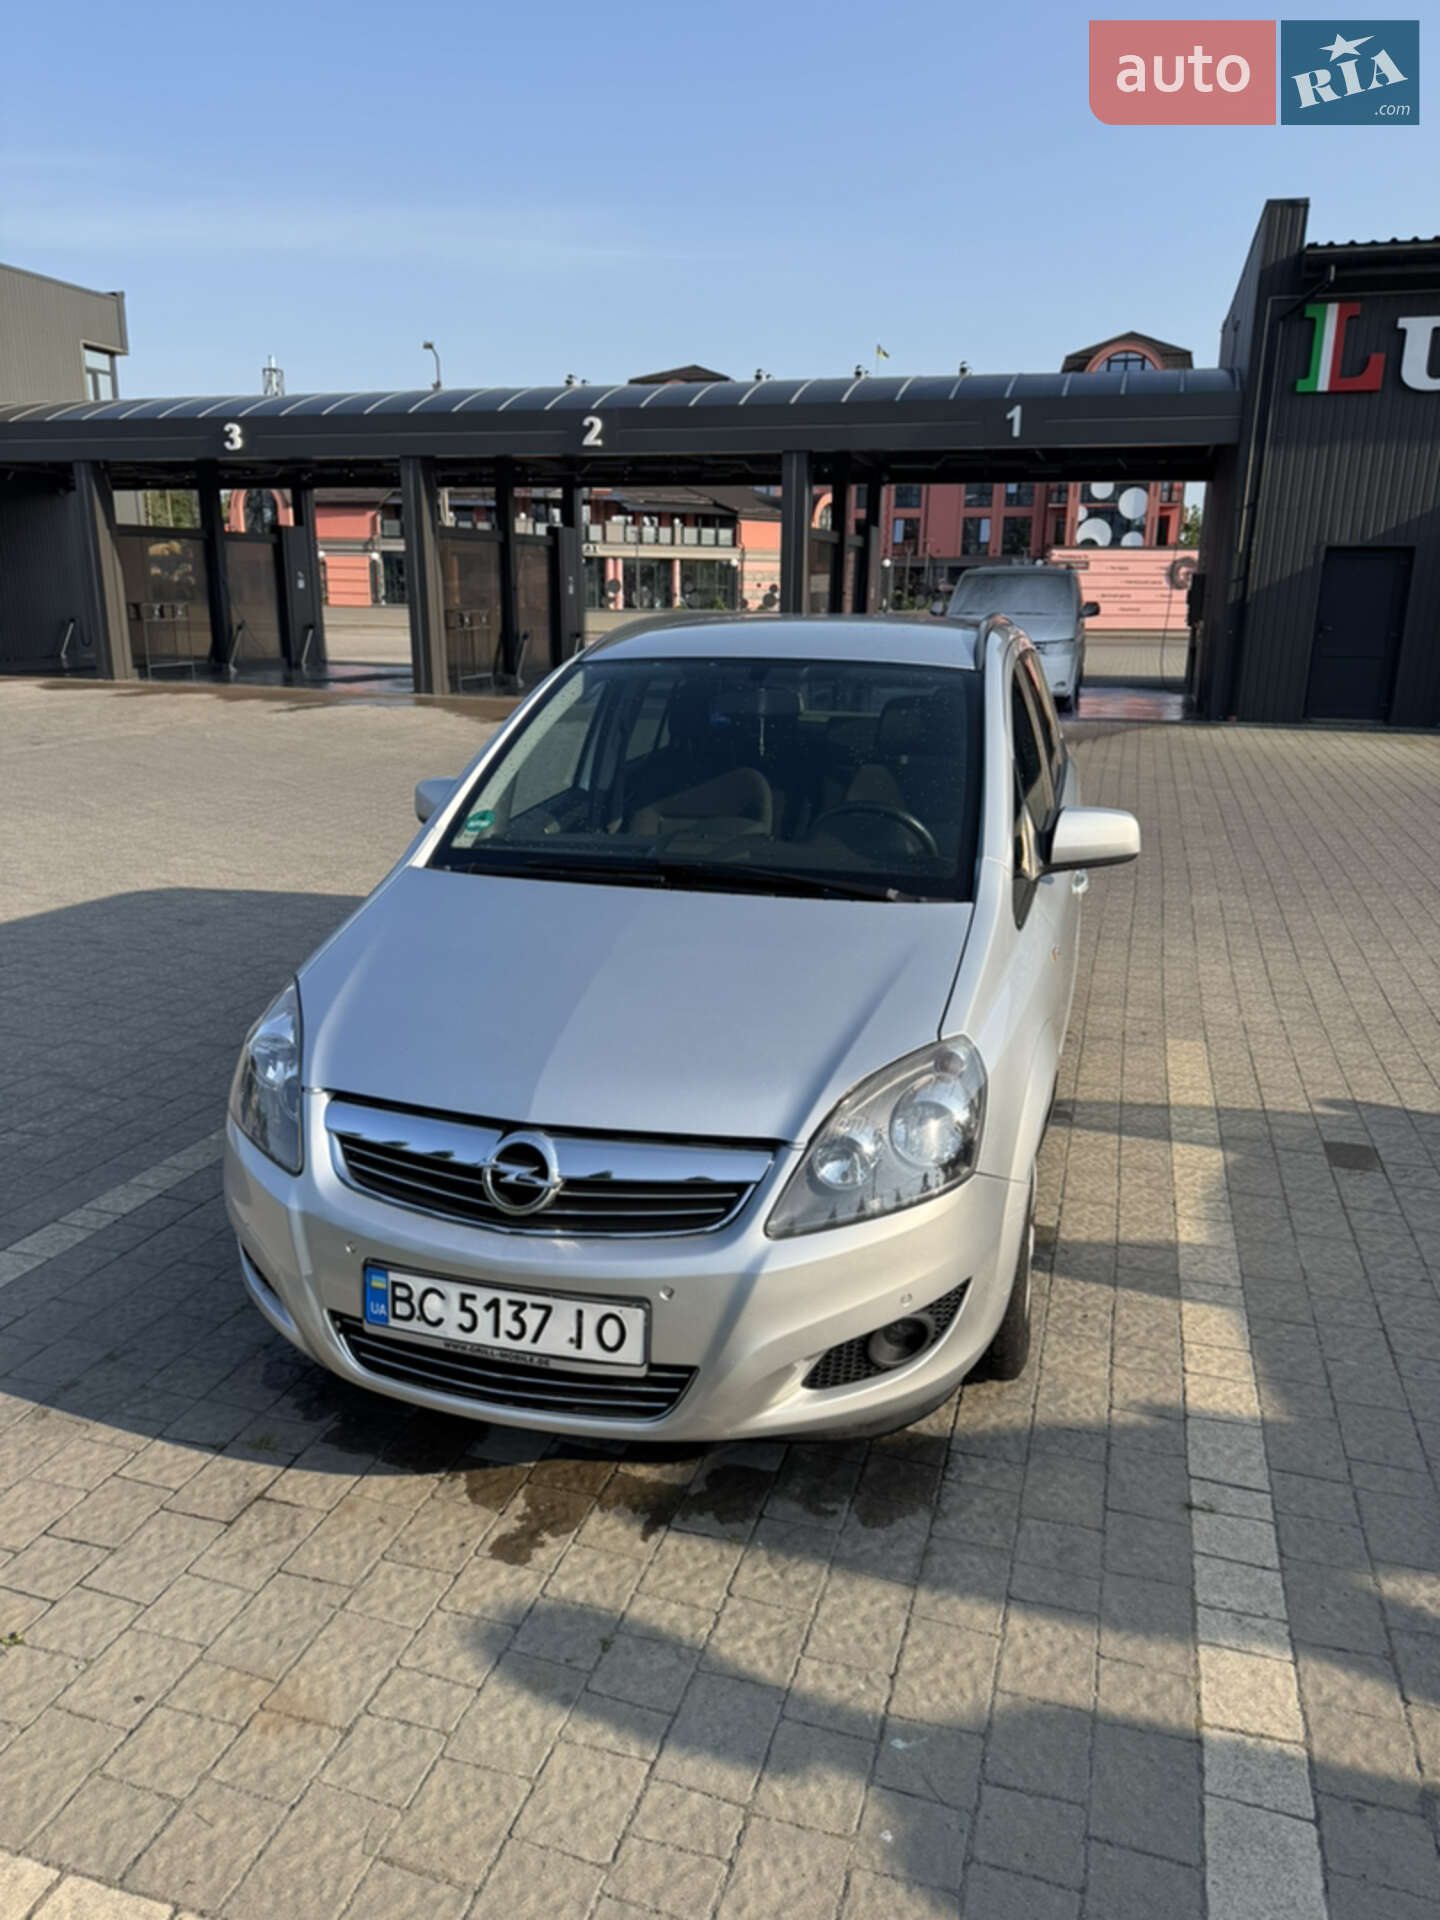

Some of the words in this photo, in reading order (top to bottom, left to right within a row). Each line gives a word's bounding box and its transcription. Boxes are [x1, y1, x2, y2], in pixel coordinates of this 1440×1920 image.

[223, 422, 242, 450] 3
[582, 415, 602, 446] 2
[1006, 404, 1021, 437] 1
[370, 1301, 388, 1317] UA
[391, 1280, 445, 1327] BC
[458, 1292, 552, 1344] 5137
